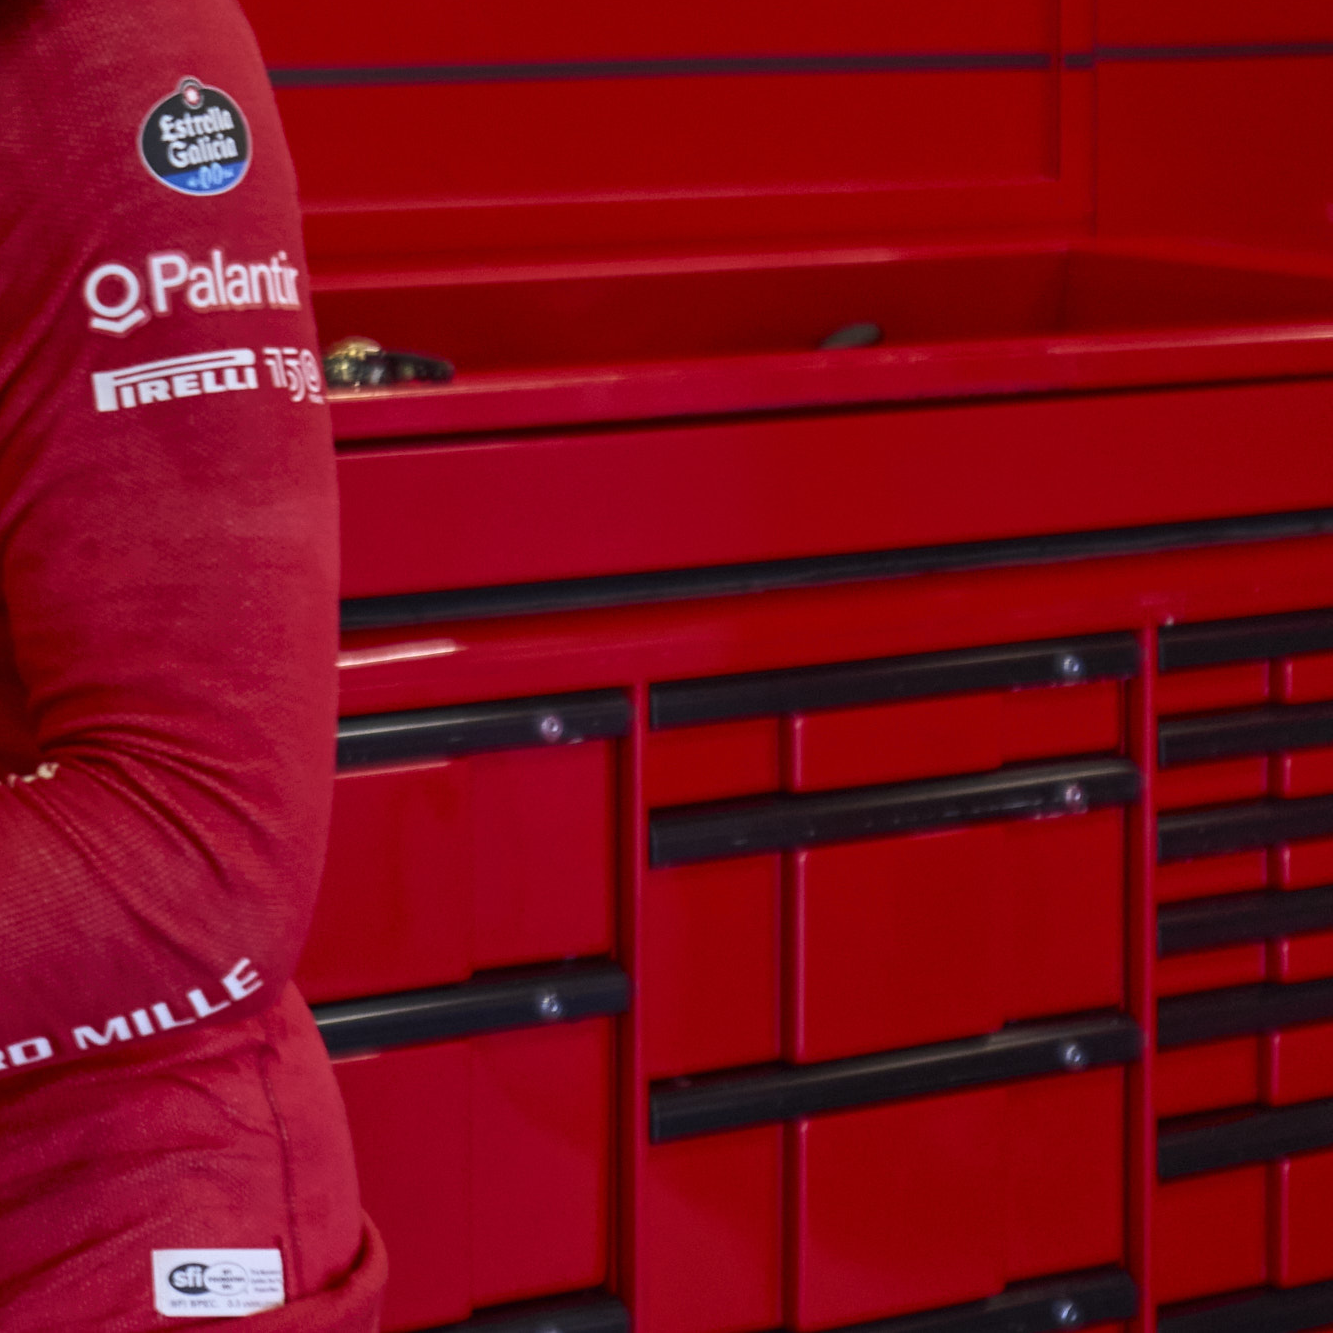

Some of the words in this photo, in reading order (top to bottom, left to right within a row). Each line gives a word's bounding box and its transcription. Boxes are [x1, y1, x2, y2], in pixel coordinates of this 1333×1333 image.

[159, 106, 235, 142] Estrella
[167, 133, 239, 168] Galicia
[149, 249, 300, 313] Palantir
[92, 348, 259, 412] PIRELLI
[71, 957, 264, 1051] MILLE
